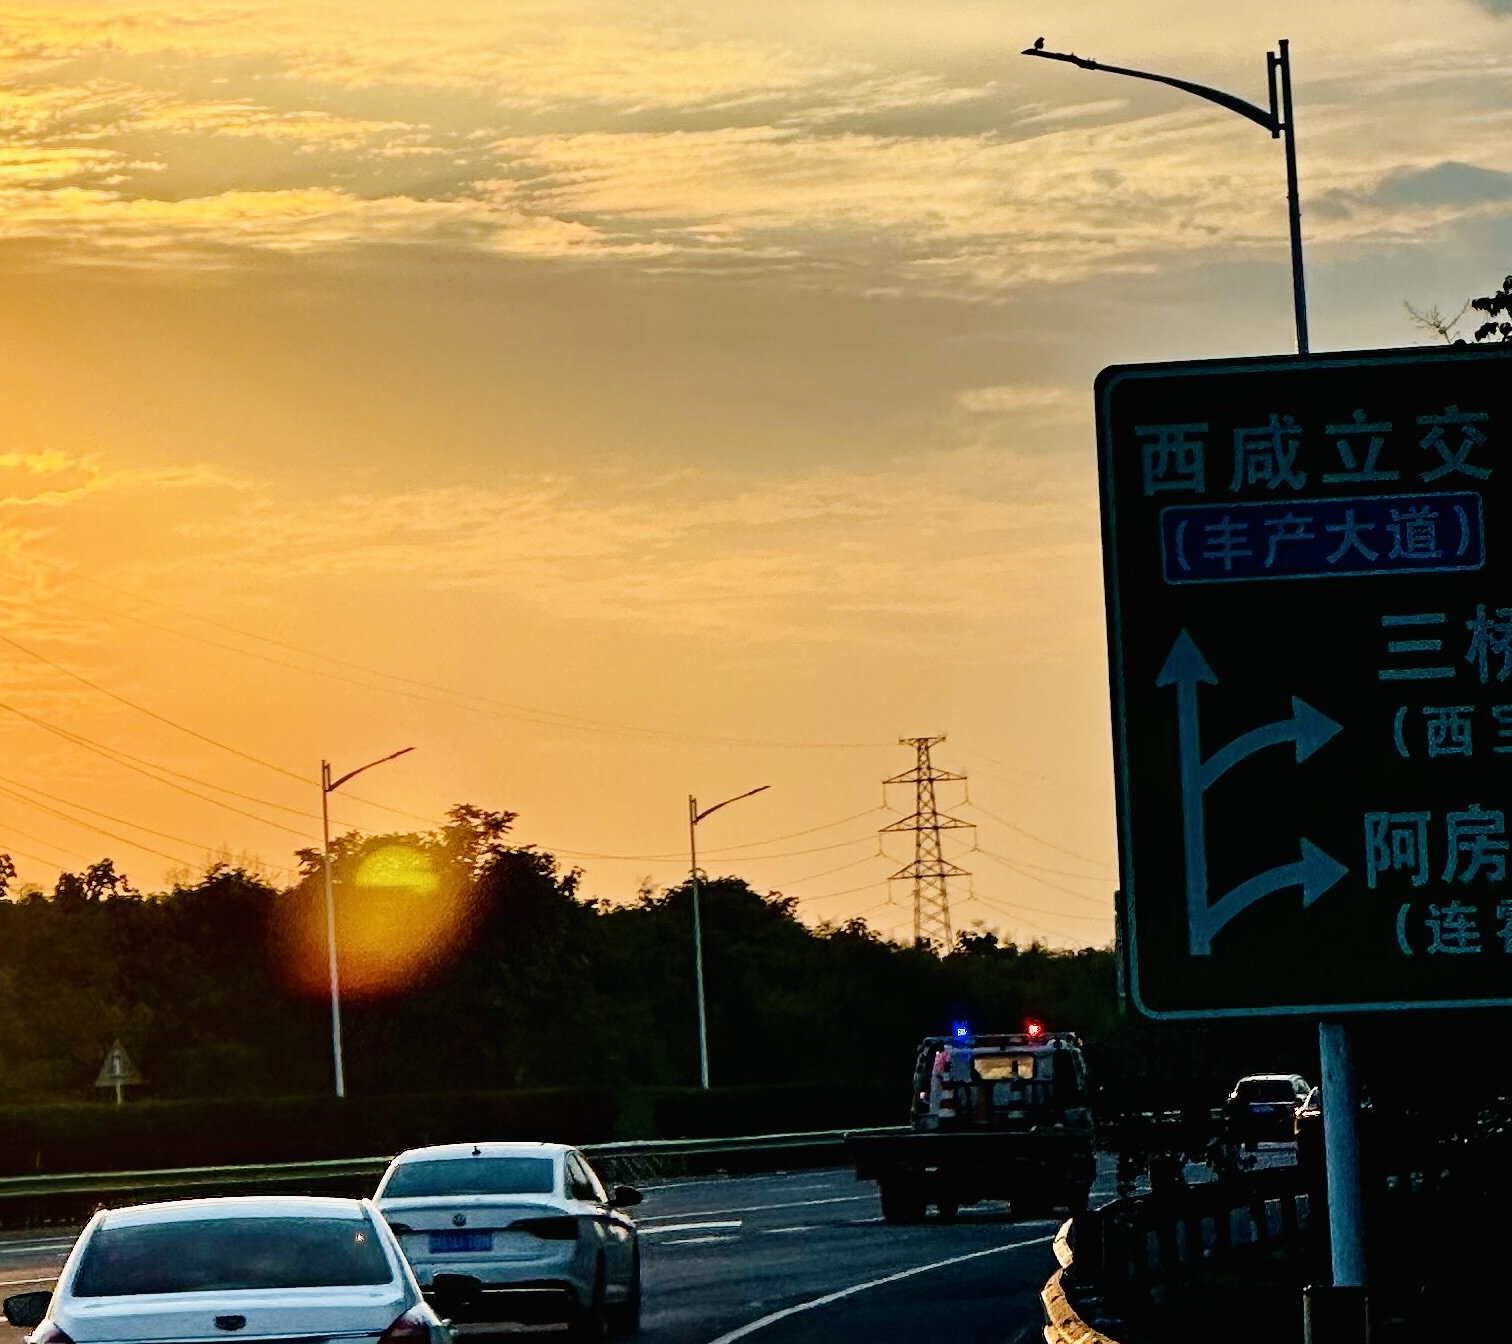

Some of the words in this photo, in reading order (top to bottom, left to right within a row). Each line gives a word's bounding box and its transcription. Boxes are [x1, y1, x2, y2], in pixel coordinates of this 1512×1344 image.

[1135, 405, 1491, 495] 西咸立交
[1364, 803, 1511, 888] 阿房
